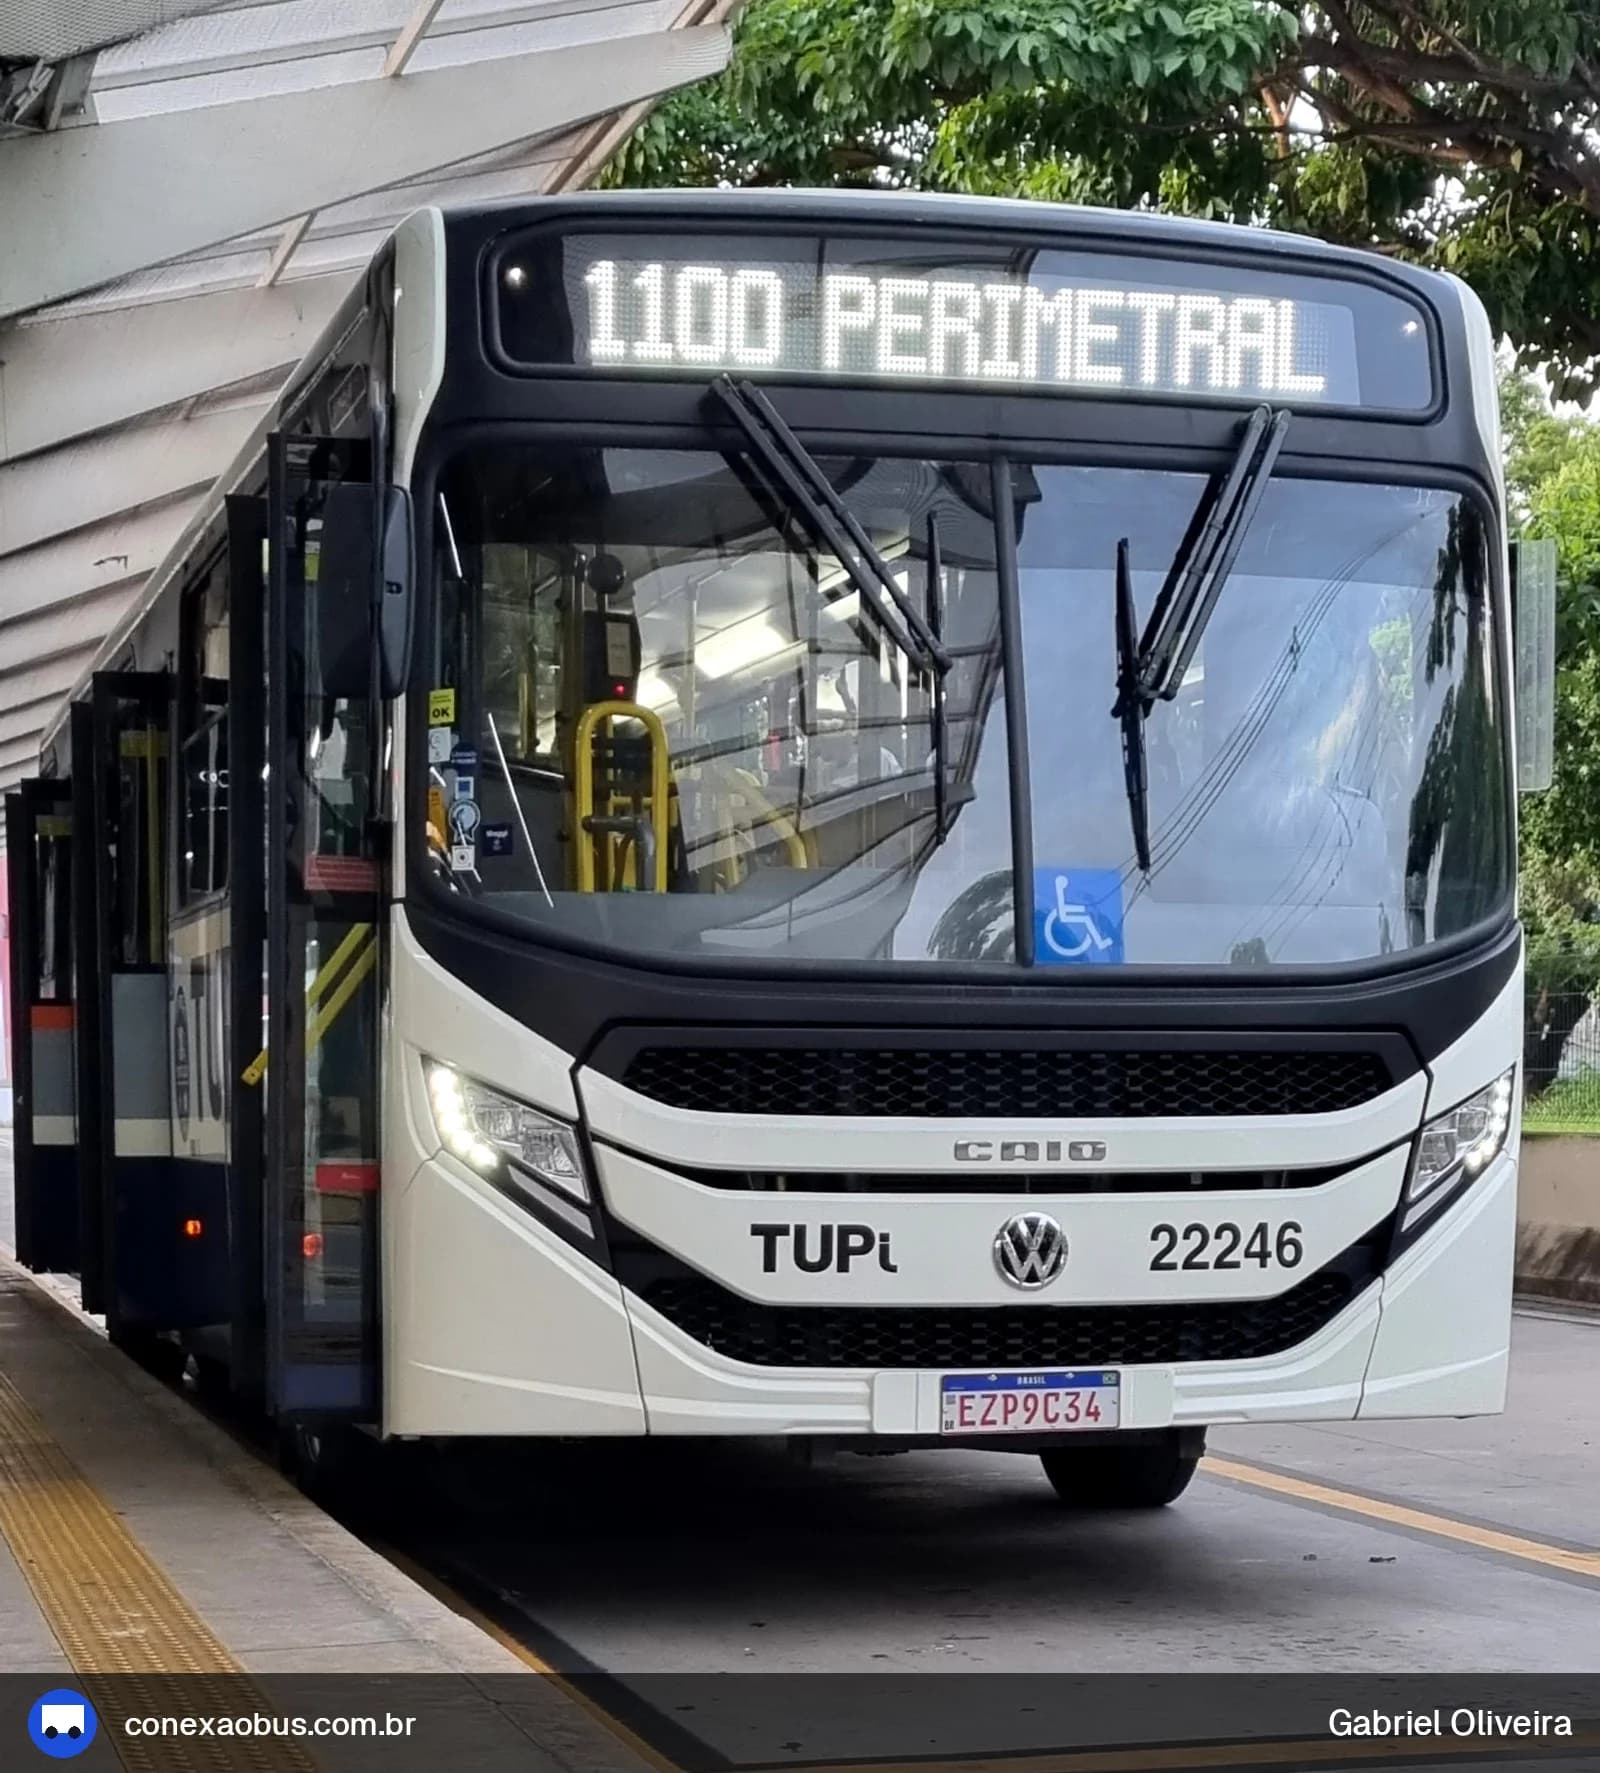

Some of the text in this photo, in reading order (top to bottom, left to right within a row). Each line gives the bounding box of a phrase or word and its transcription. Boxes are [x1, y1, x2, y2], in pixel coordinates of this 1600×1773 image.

[585, 261, 1326, 393] 1100 PERIMETRAL
[432, 707, 450, 718] OK
[954, 1141, 1107, 1161] CAIO
[1149, 1221, 1304, 1271] 22246
[1017, 1376, 1047, 1385] BRASIL
[959, 1391, 1101, 1427] EZP9C34
